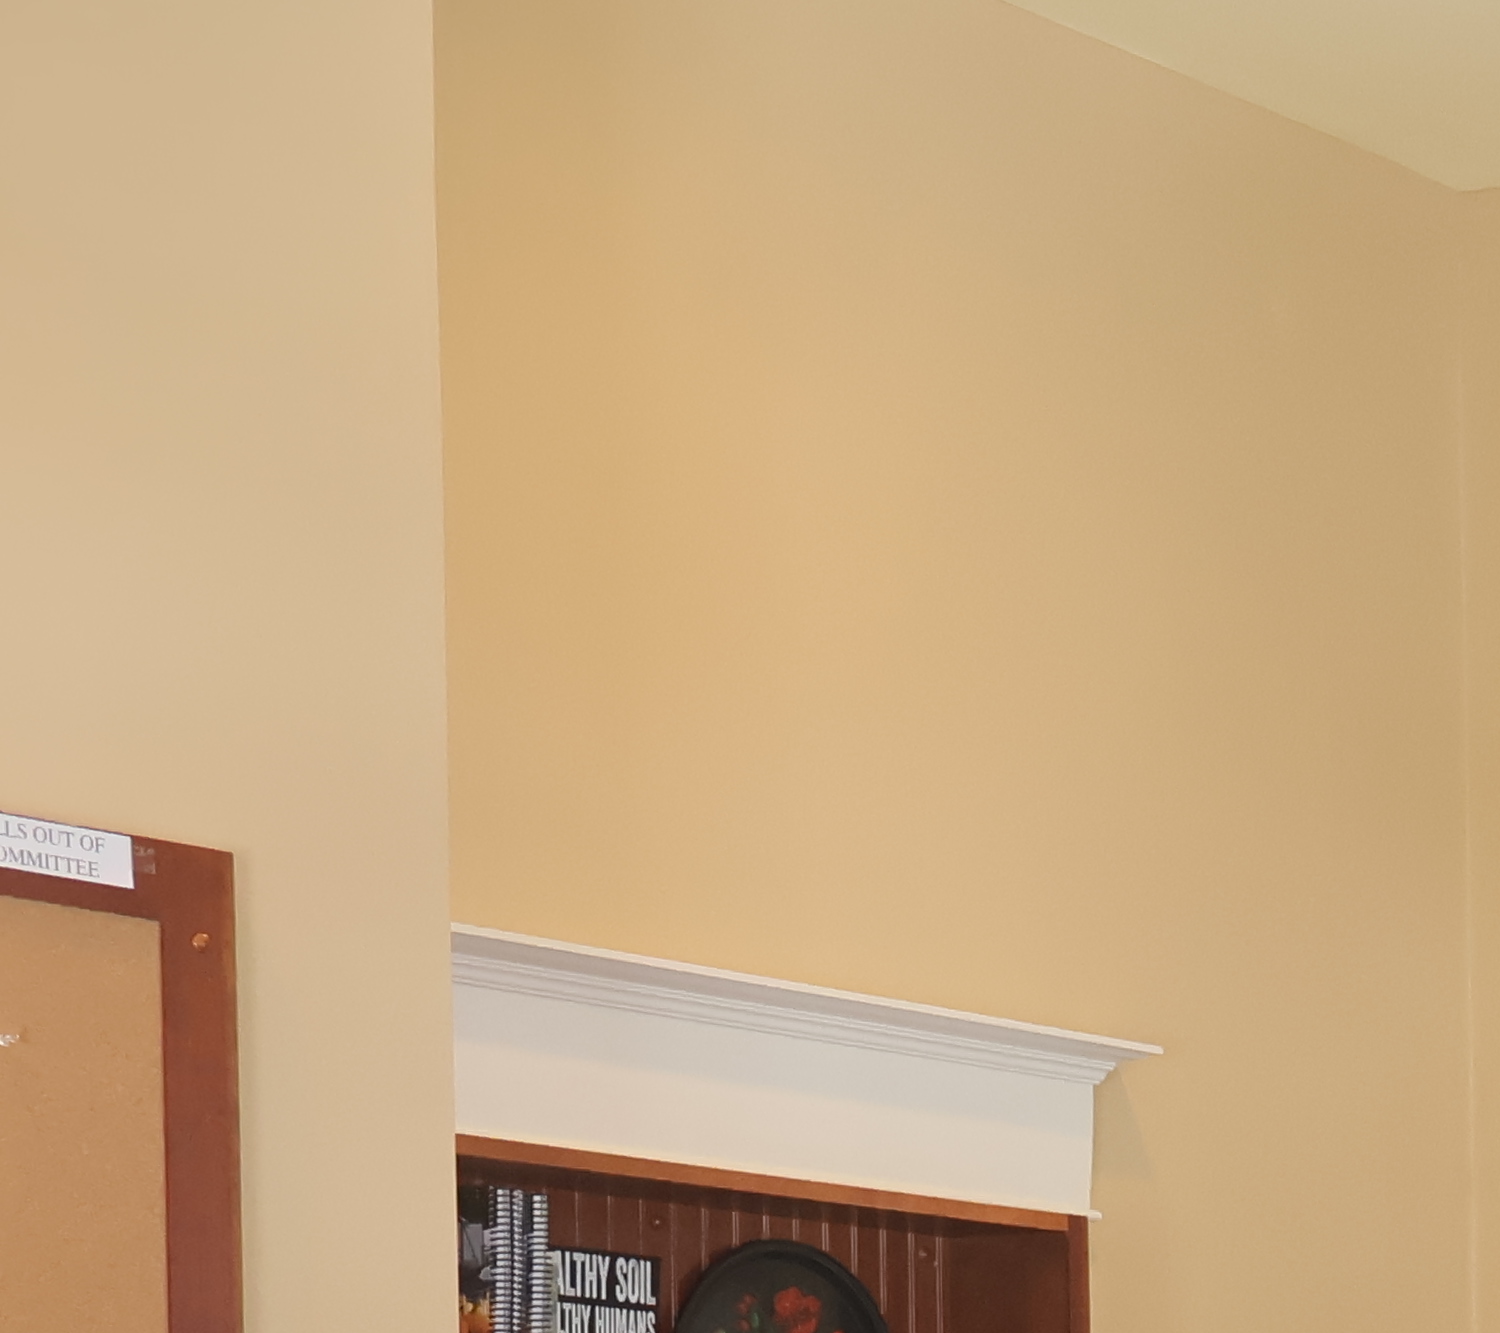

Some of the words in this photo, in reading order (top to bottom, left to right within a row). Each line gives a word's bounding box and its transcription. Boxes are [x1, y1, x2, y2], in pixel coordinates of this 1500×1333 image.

[33, 826, 74, 848] OUT
[79, 834, 105, 853] OF
[556, 1251, 610, 1300] ALTHY
[615, 1256, 656, 1305] SOIL
